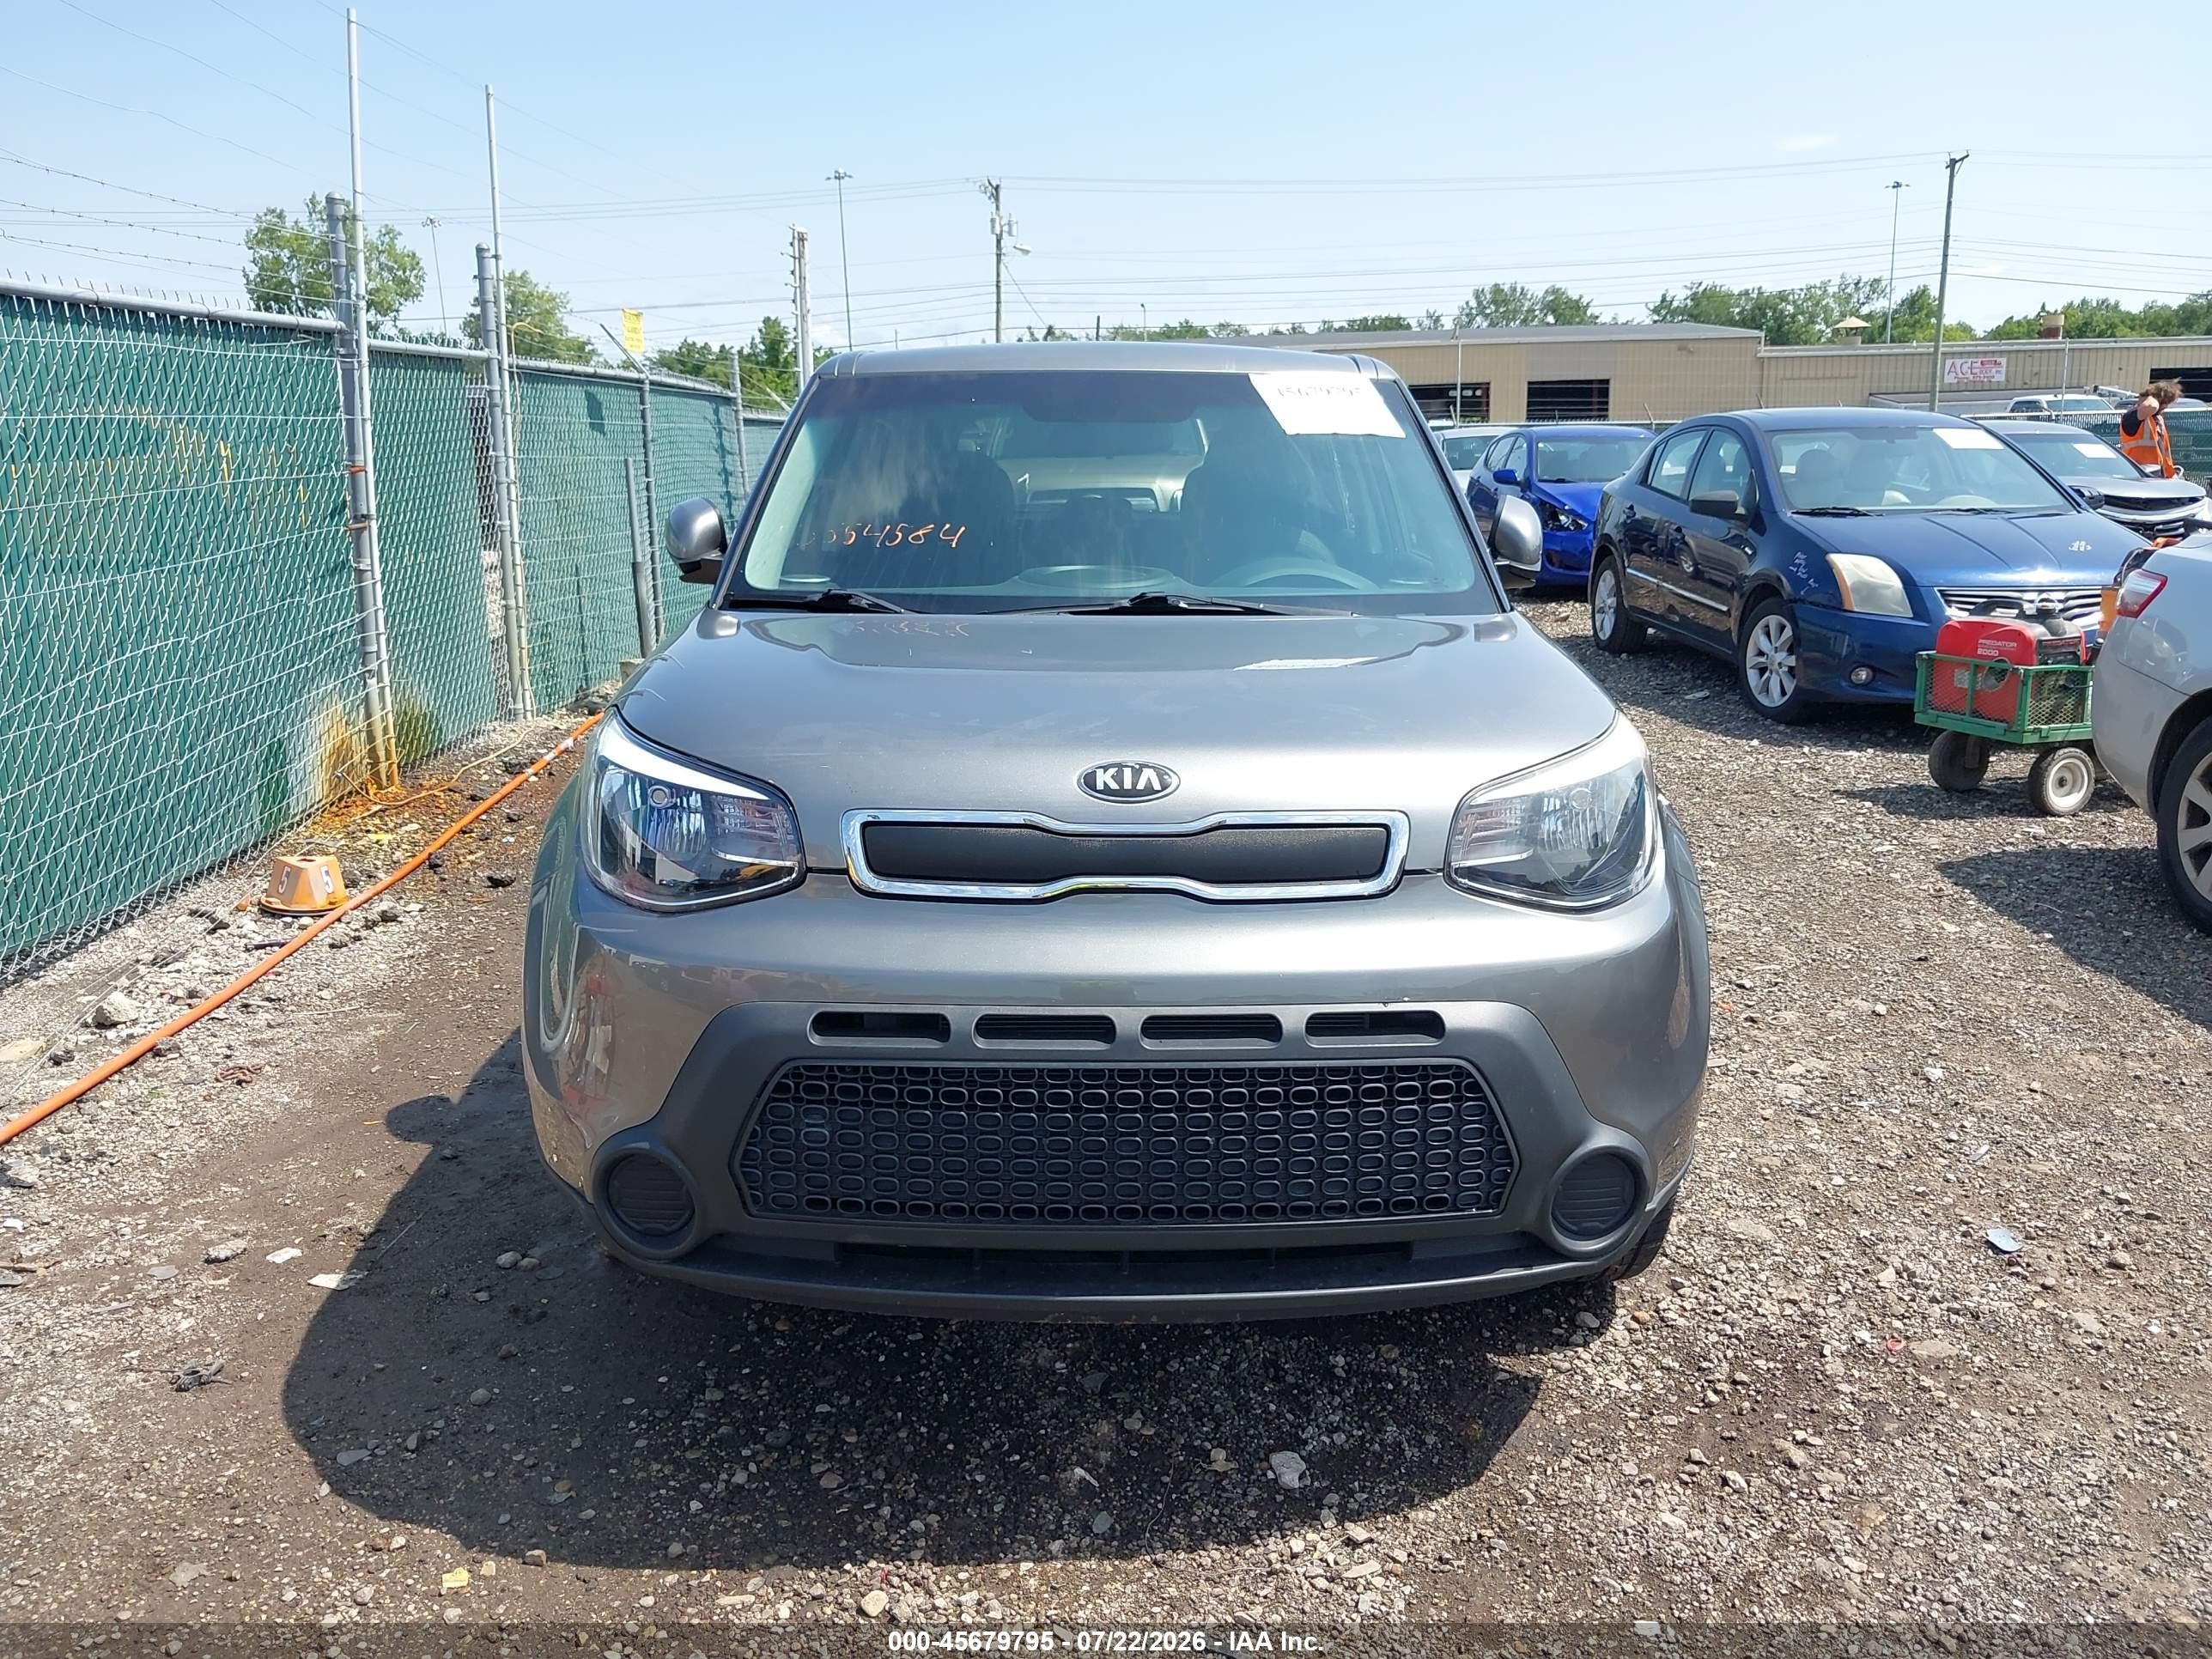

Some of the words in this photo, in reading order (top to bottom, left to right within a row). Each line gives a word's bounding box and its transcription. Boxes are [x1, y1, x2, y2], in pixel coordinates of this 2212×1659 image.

[1948, 361, 1978, 375] ACE
[1977, 647, 1999, 656] 2000
[1978, 639, 2017, 647] PREDATOR
[1095, 767, 1162, 790] KIA
[277, 866, 291, 894] 5
[320, 865, 334, 894] 5
